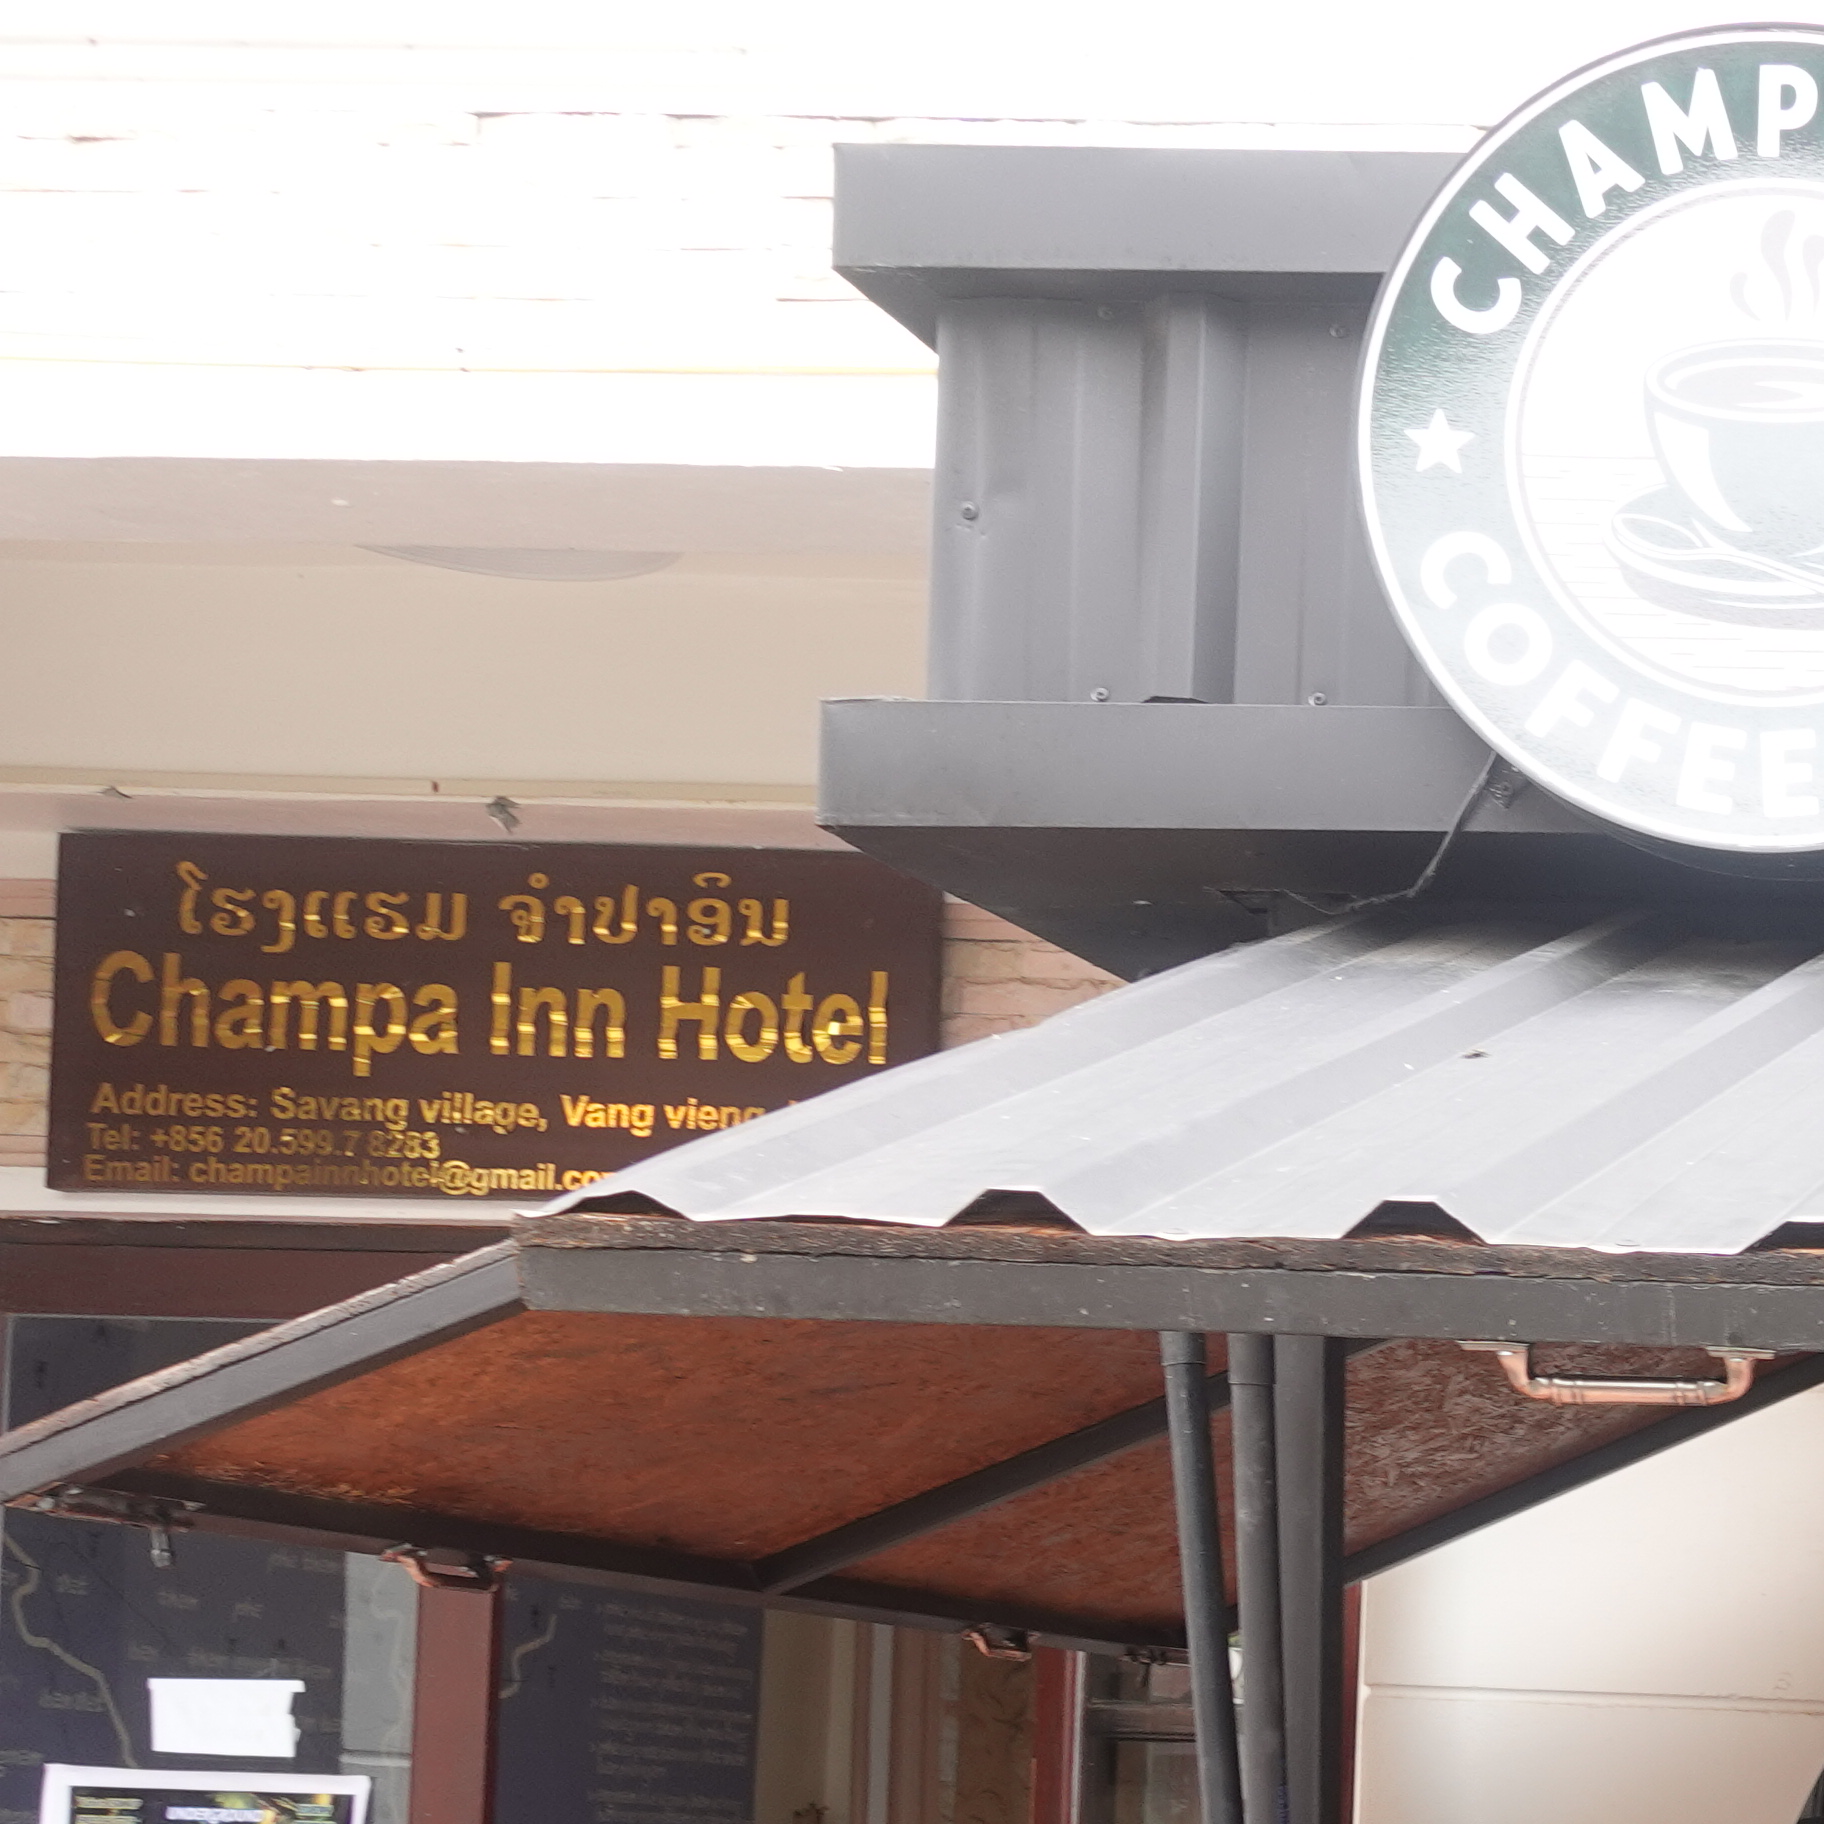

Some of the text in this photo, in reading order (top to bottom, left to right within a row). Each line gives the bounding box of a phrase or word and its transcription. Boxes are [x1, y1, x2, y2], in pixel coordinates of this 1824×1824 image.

[1419, 530, 1820, 820] COFFEE
[90, 949, 889, 1076] Champa Inn Hotel
[90, 1082, 257, 1118] Address:
[270, 1086, 409, 1130] Savang
[419, 1090, 549, 1134] village,
[560, 1094, 656, 1137] Vang
[87, 1122, 138, 1151] Tel:
[150, 1124, 225, 1153] +856
[83, 1154, 618, 1197] Email: champainnhotel@gmail.co
